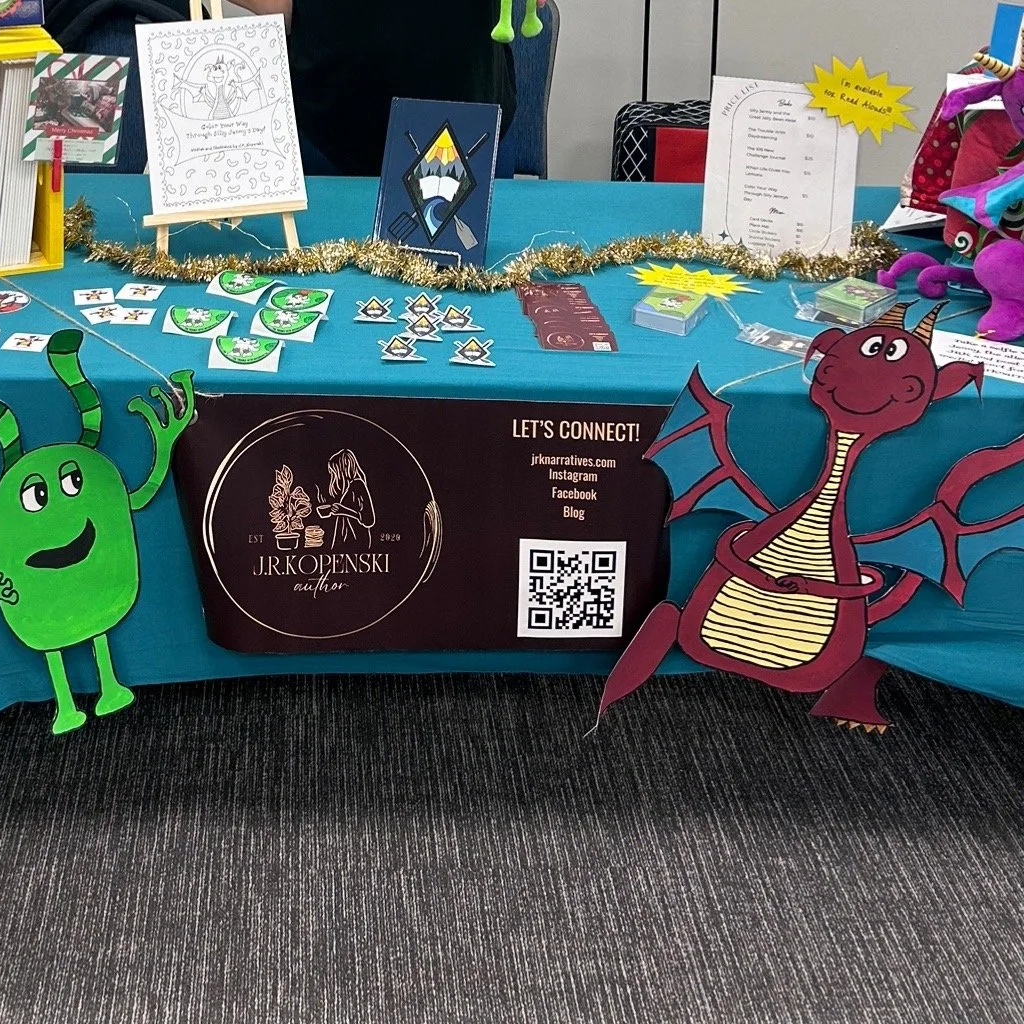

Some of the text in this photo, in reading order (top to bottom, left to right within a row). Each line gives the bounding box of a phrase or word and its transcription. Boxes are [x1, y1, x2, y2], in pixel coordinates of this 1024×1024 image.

[854, 84, 883, 97] available
[721, 94, 740, 116] PRICE
[840, 93, 859, 105] Read
[512, 418, 640, 442] LET'S CONNECT!
[530, 453, 616, 468] jrknarratives.com
[549, 468, 598, 483] Instagram
[552, 487, 597, 501] Facebook
[563, 505, 585, 521] Blog
[248, 534, 264, 544] EST
[380, 533, 401, 542] 2020
[293, 568, 350, 599] author
